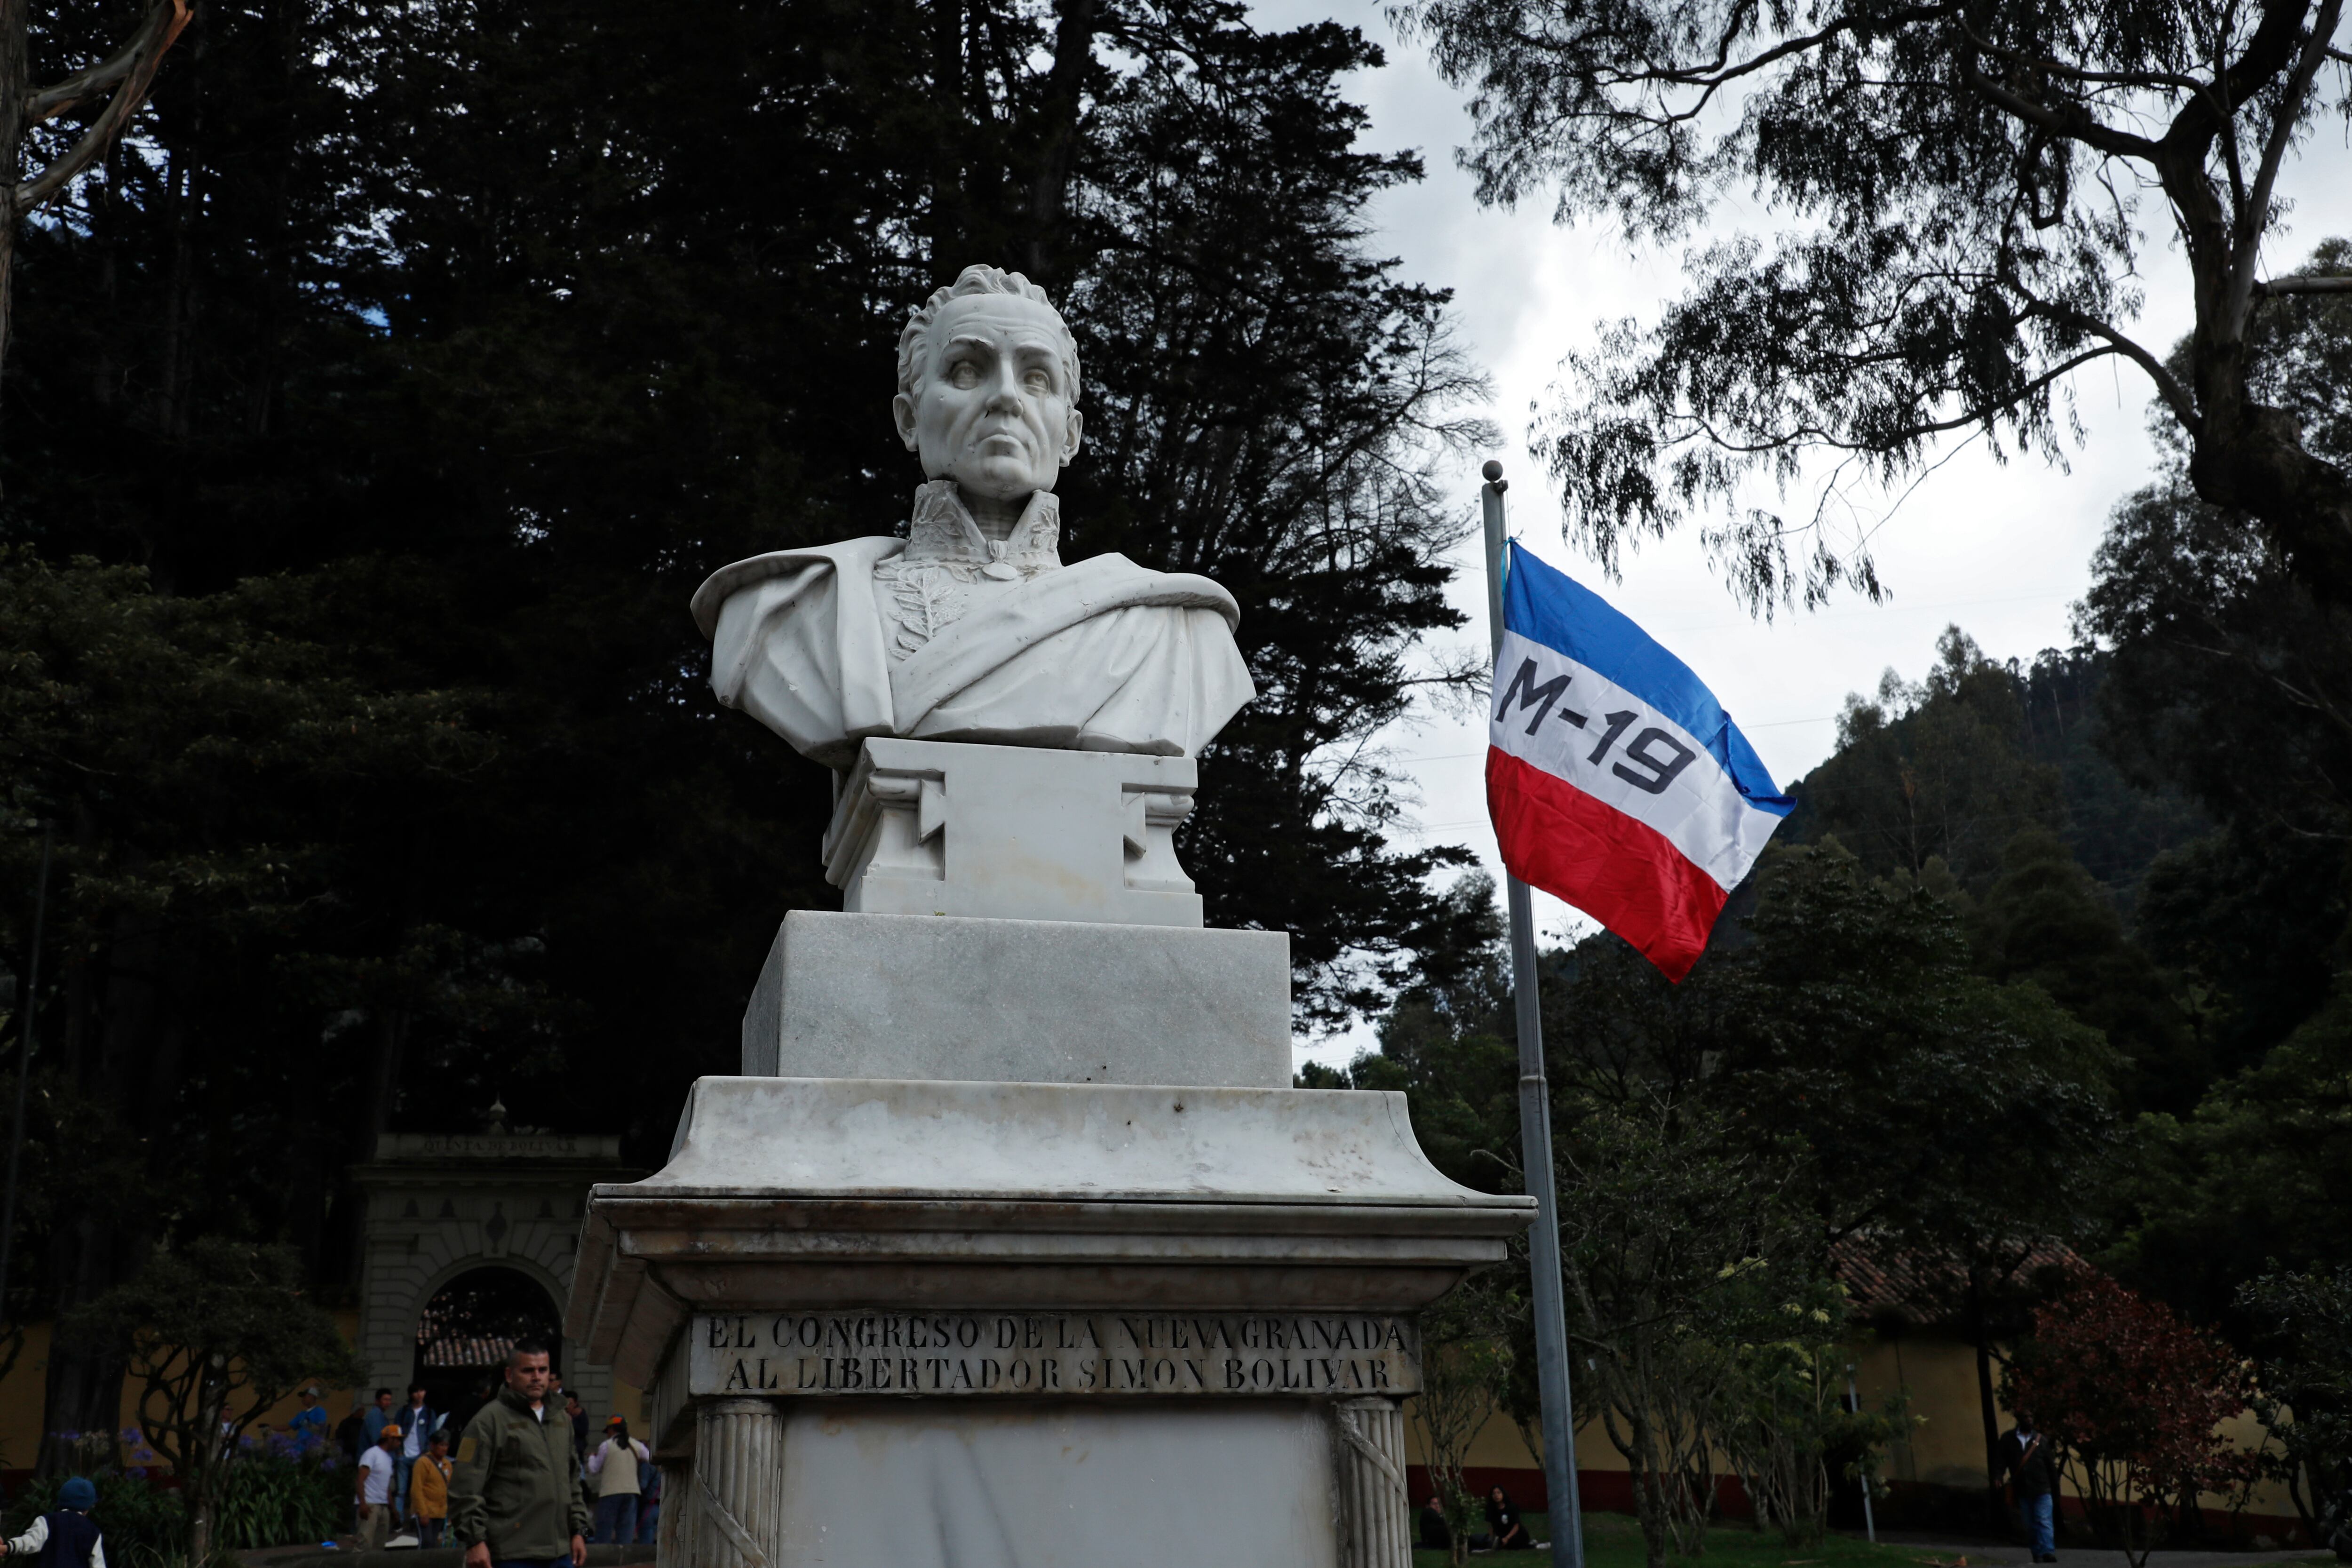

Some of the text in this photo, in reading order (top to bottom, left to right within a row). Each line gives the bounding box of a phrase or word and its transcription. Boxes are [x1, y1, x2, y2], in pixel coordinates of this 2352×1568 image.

[1494, 656, 1696, 795] M-19
[424, 1140, 483, 1153] QUINTA
[707, 1317, 1405, 1350] EL CONGRESO DE LA NUEVA GRANADA
[725, 1358, 1389, 1390] AL LIBERTADOR SIMON BOLIVAR
